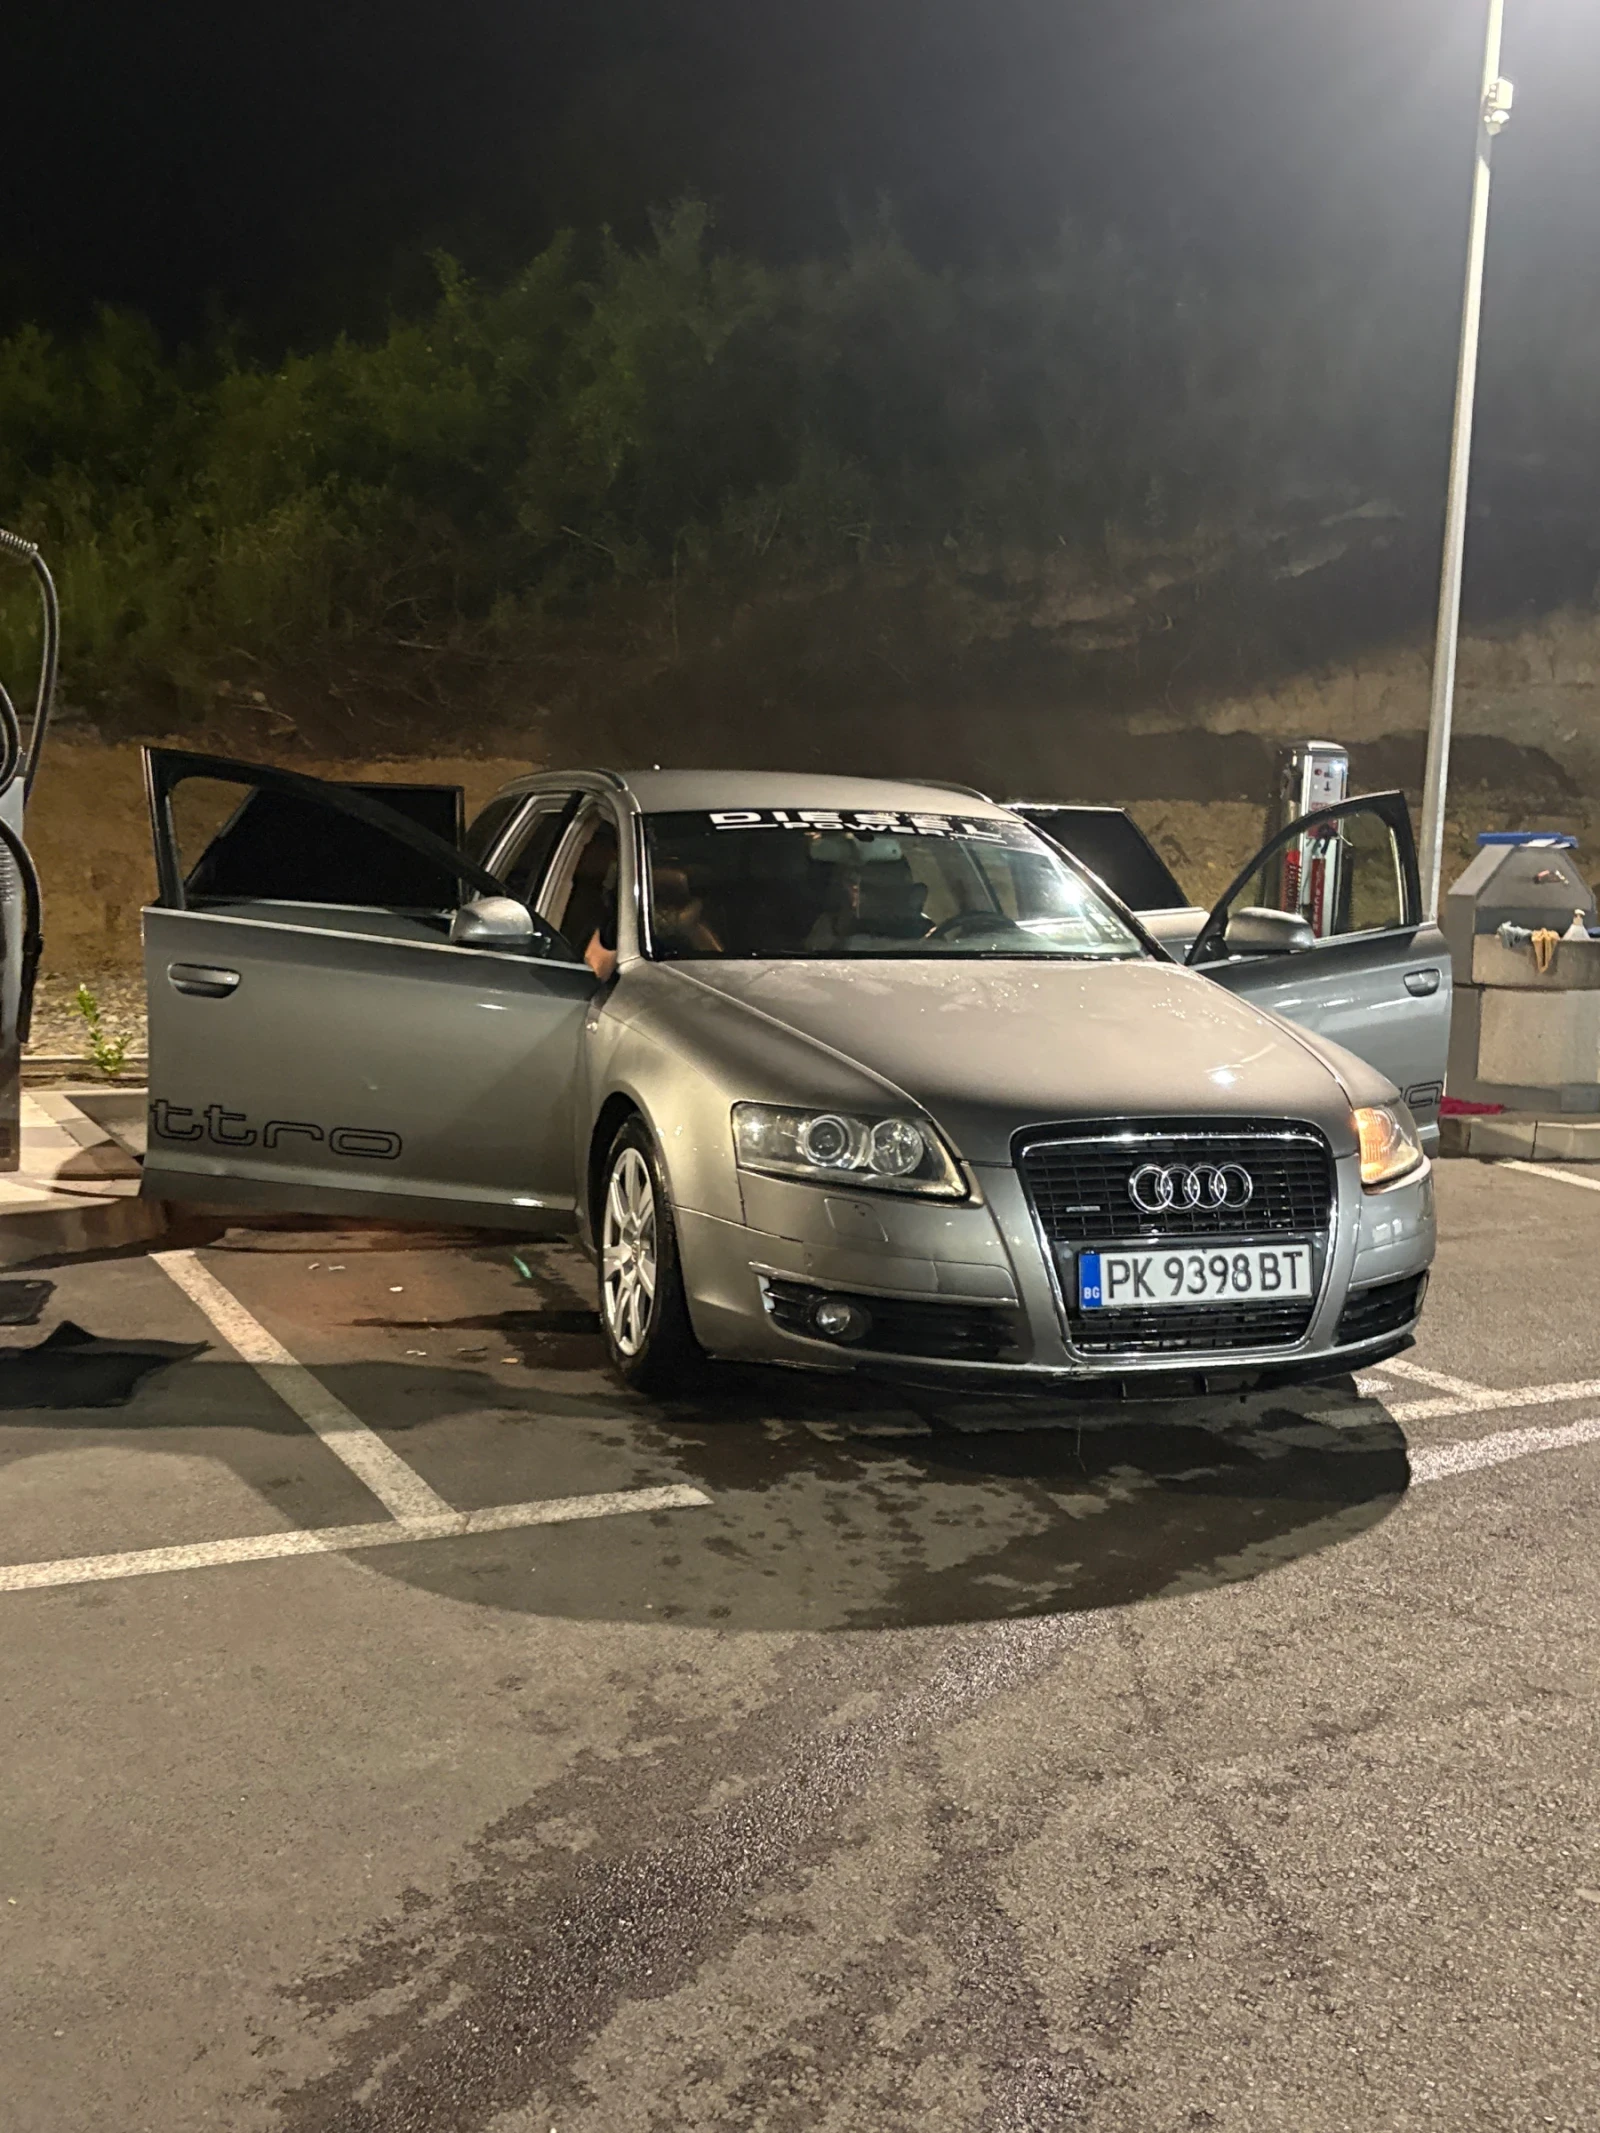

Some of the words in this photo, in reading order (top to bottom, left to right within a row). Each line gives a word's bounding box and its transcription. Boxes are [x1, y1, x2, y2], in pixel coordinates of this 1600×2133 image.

[708, 810, 1002, 839] DIESEL
[784, 821, 945, 837] POWER
[1106, 1257, 1156, 1299] PK
[1163, 1253, 1252, 1296] 9398
[1259, 1251, 1303, 1291] BT
[1083, 1286, 1100, 1300] BG
